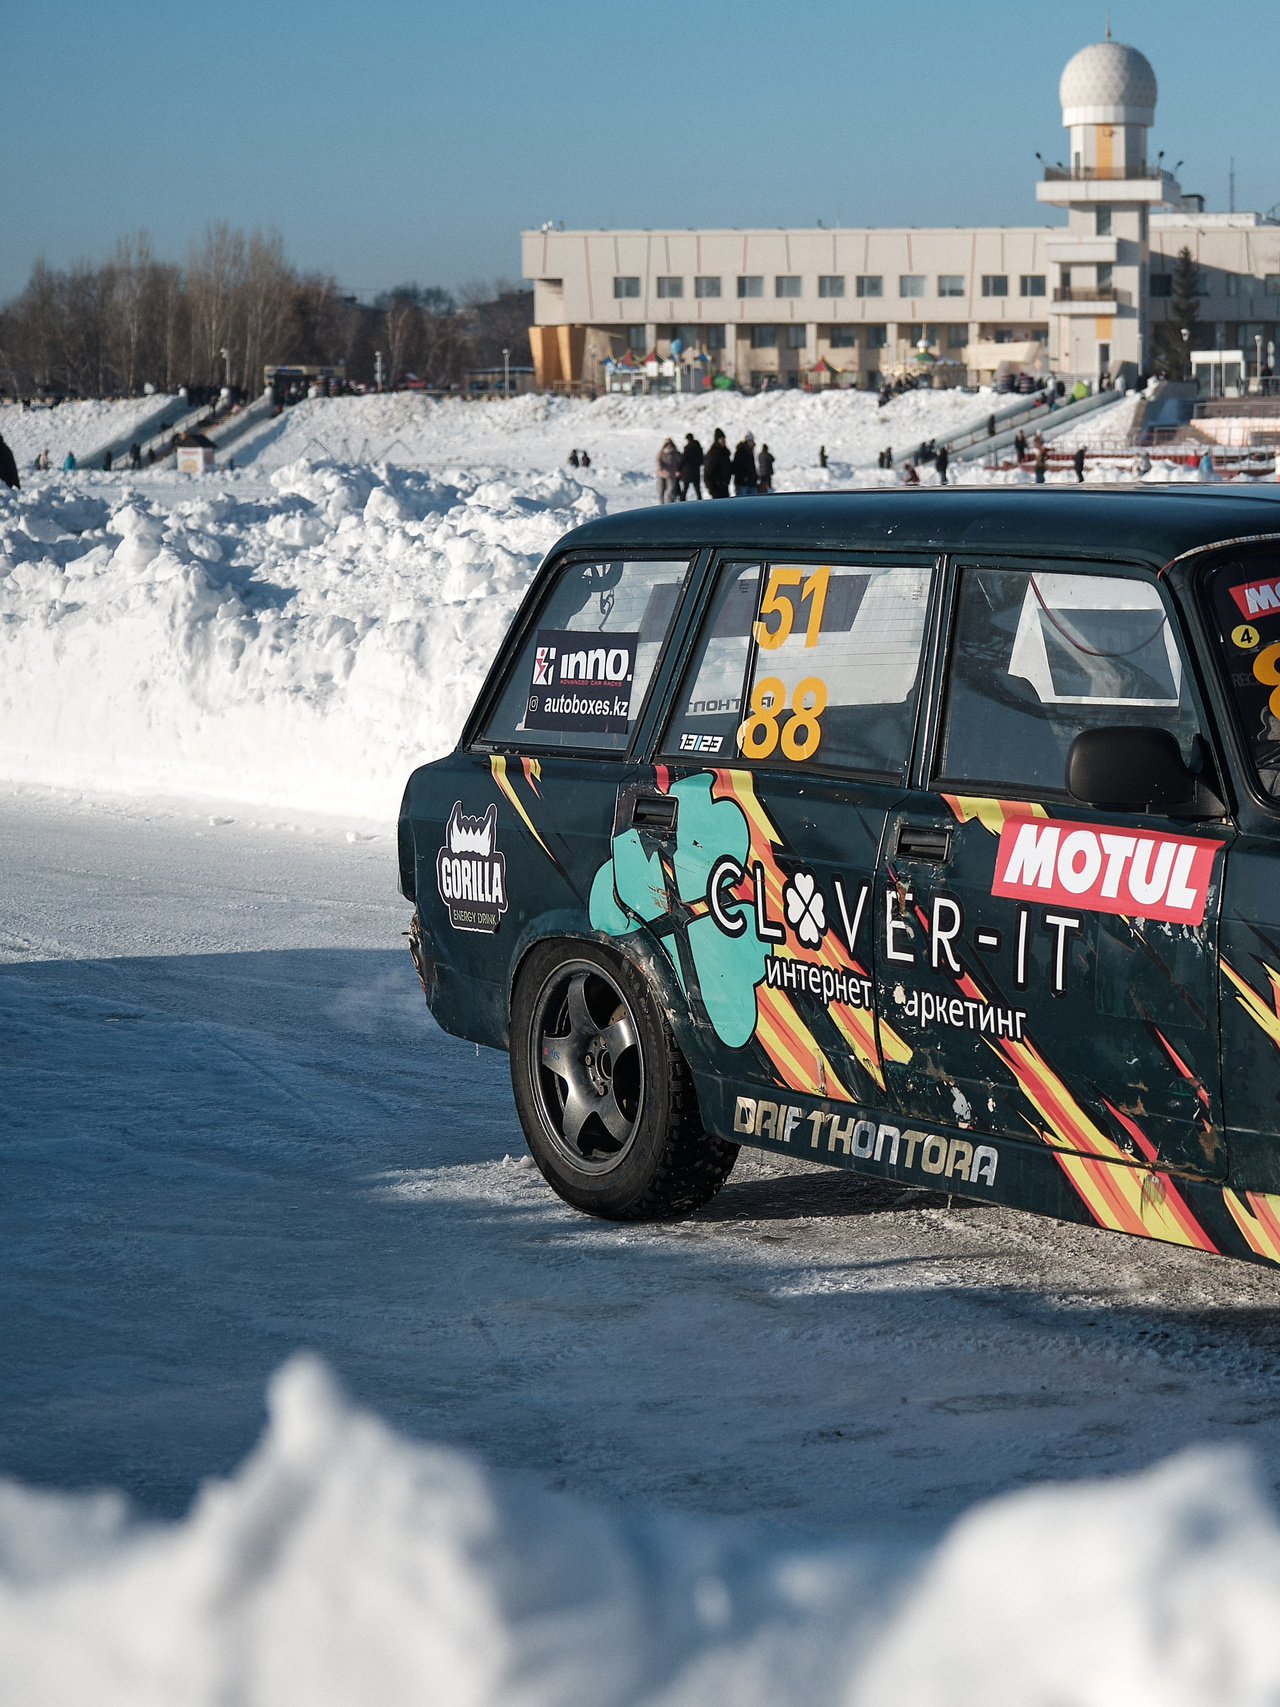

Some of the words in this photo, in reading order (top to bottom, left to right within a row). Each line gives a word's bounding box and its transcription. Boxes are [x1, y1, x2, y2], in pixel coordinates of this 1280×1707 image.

[753, 565, 831, 650] 51
[544, 694, 628, 717] autoboxes.kz
[736, 676, 828, 762] 88
[441, 856, 503, 904] GORILLA
[1002, 823, 1198, 910] MOTUL
[453, 909, 476, 923] ENERGY
[477, 913, 496, 925] DRINK
[767, 958, 873, 1008] интернет
[904, 990, 1027, 1039] аркетинг
